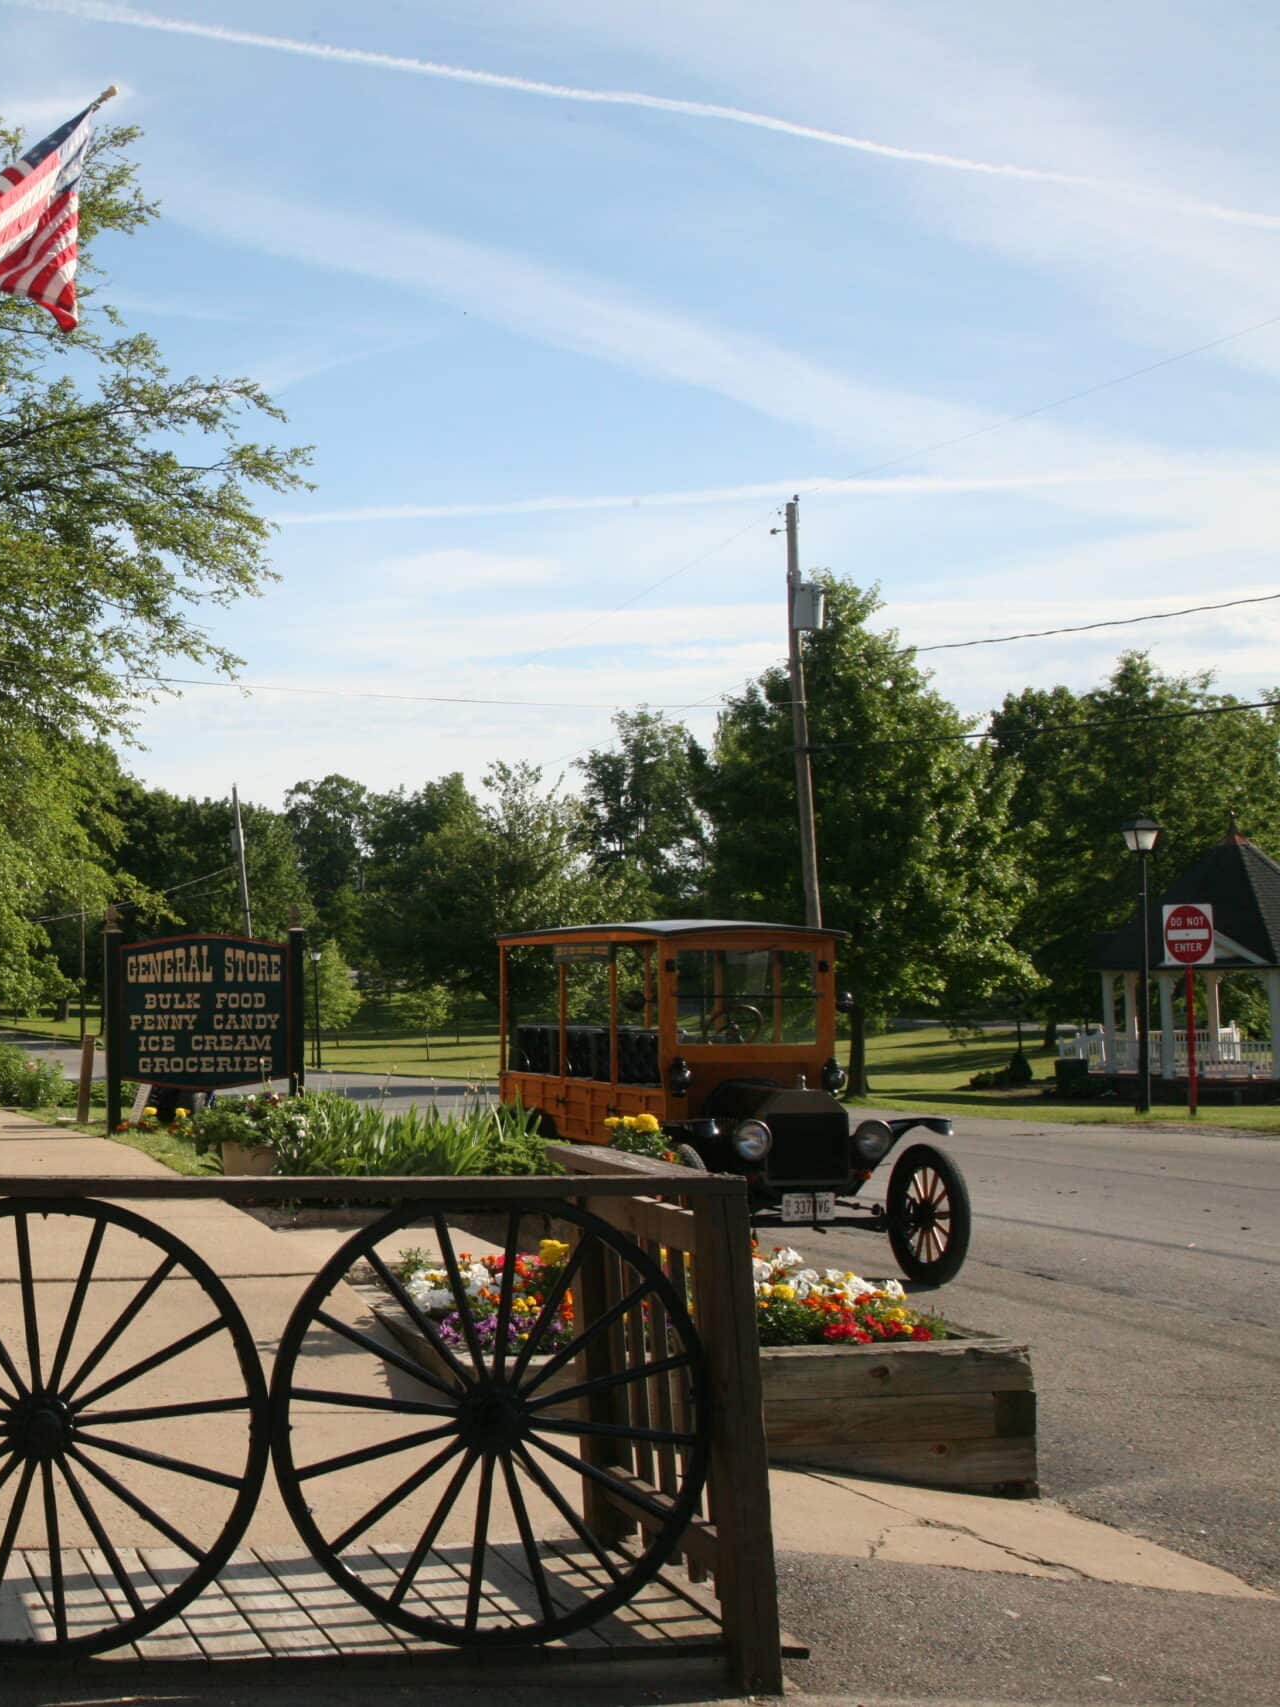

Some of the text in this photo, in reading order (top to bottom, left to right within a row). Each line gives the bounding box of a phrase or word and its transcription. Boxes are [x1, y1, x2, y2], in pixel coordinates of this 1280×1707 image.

[1170, 916, 1204, 926] DO NOT
[1174, 942, 1202, 952] ENTER
[128, 945, 281, 983] GENERAL STORE
[145, 993, 266, 1009] BULK FOOD
[129, 1014, 280, 1030] PENNY CANDY
[139, 1035, 272, 1051] ICE CREAM
[139, 1057, 272, 1073] GROCERIES
